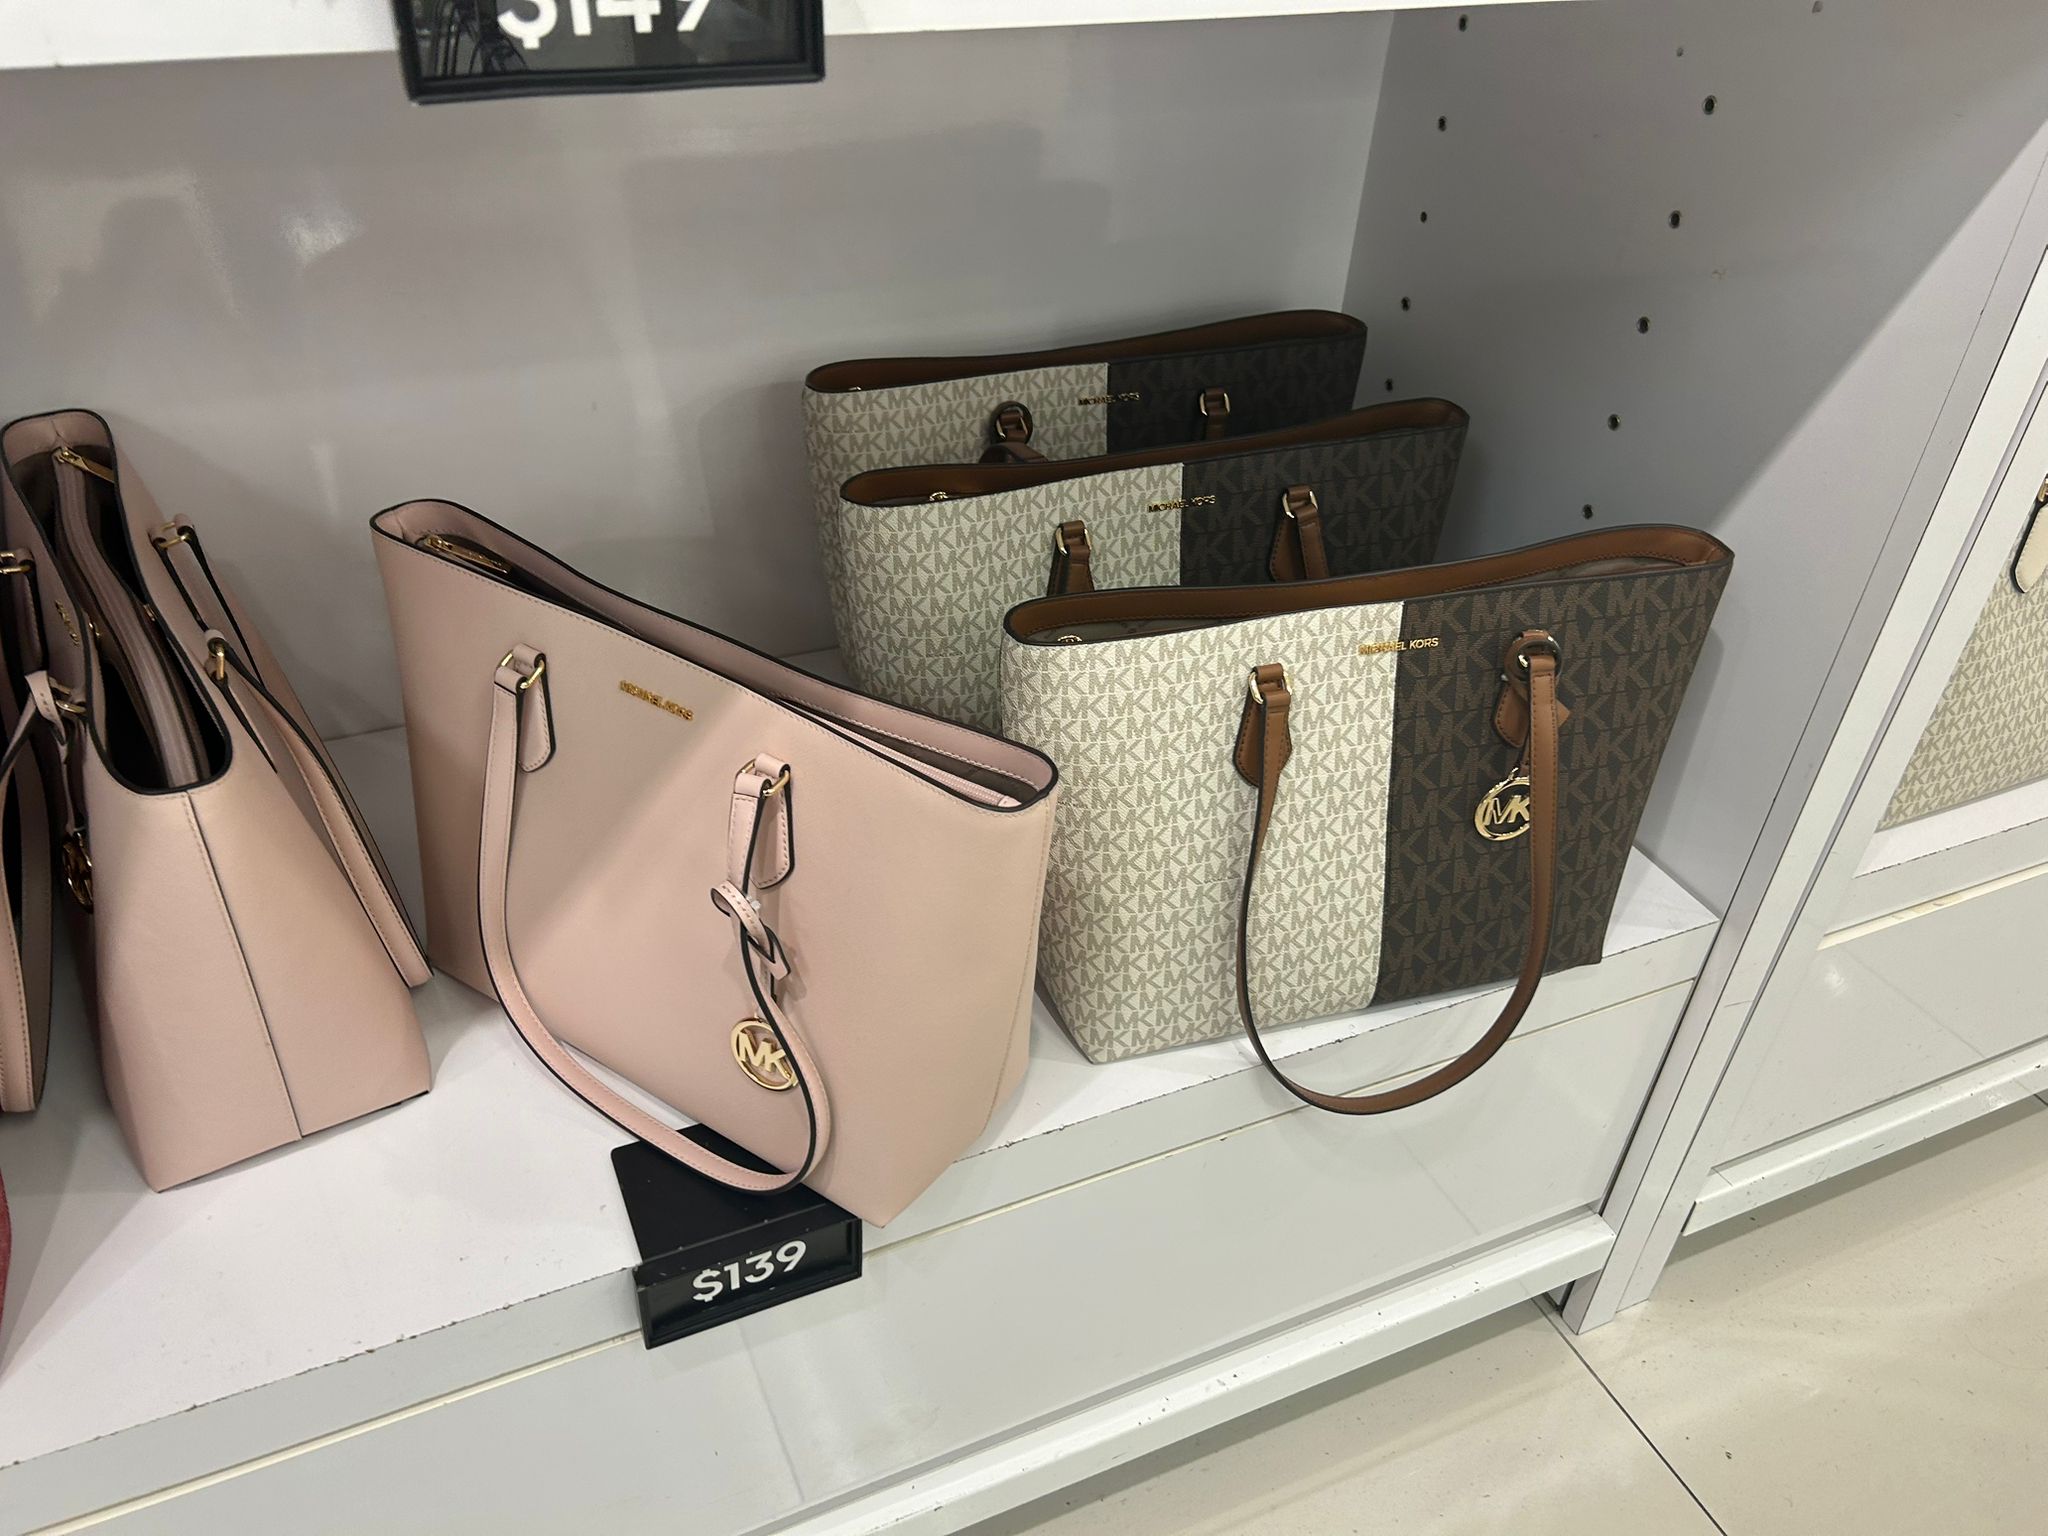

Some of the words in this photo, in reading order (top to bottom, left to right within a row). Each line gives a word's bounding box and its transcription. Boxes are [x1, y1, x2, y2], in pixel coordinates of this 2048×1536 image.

[898, 507, 937, 533] MK
[939, 502, 975, 528] MK
[977, 497, 1010, 521] MK
[1013, 490, 1044, 514] MK
[1046, 484, 1077, 508] MK
[1079, 477, 1110, 501] MK
[1112, 472, 1145, 496] MK
[1146, 467, 1179, 491] MK
[1092, 494, 1125, 520] MK
[875, 530, 914, 556] MK
[917, 526, 956, 554] MK
[956, 520, 992, 548] MK
[992, 513, 1025, 541] MK
[1027, 507, 1058, 533] MK
[1106, 513, 1139, 539] MK
[894, 551, 933, 577] MK
[934, 546, 973, 574] MK
[973, 540, 1006, 566] MK
[1007, 532, 1040, 560] MK
[1089, 538, 1120, 564] MK
[1121, 532, 1154, 558] MK
[912, 572, 951, 598] MK
[952, 566, 988, 592] MK
[988, 559, 1021, 585] MK
[1022, 552, 1053, 576] MK
[1103, 557, 1134, 581] MK
[1135, 550, 1168, 576] MK
[890, 595, 929, 619] MK
[930, 591, 969, 617] MK
[970, 585, 1003, 611] MK
[1004, 577, 1035, 601] MK
[908, 615, 947, 639] MK
[949, 610, 985, 636] MK
[1241, 622, 1277, 649] MK
[1281, 616, 1317, 643] MK
[1319, 612, 1358, 637] MK
[1361, 606, 1397, 631] MK
[926, 634, 965, 660] MK
[966, 628, 999, 654] MK
[1296, 636, 1332, 665] MK
[1409, 636, 1440, 650] KORS
[944, 654, 980, 678] MK
[1089, 667, 1131, 696] MK
[1135, 661, 1174, 690] MK
[1176, 655, 1215, 684] MK
[1311, 657, 1347, 684] MK
[1350, 654, 1386, 679] MK
[1108, 689, 1150, 718] MK
[1152, 683, 1191, 712] MK
[1194, 676, 1230, 705] MK
[1326, 678, 1362, 705] MK
[1126, 711, 1168, 740] MK
[1169, 704, 1208, 733] MK
[1303, 704, 1339, 733] MK
[1342, 698, 1378, 725] MK
[1100, 739, 1142, 766] MK
[1145, 732, 1184, 761] MK
[1186, 726, 1222, 753] MK
[1319, 725, 1355, 752] MK
[1118, 760, 1160, 787] MK
[1163, 753, 1199, 780] MK
[1295, 751, 1334, 780] MK
[1335, 745, 1371, 772] MK
[1137, 780, 1176, 807] MK
[1179, 773, 1215, 800] MK
[1312, 772, 1348, 799] MK
[1110, 806, 1152, 833] MK
[1154, 800, 1193, 827] MK
[1195, 792, 1231, 819] MK
[1289, 798, 1325, 825] MK
[1326, 791, 1362, 816] MK
[1128, 826, 1170, 853] MK
[1171, 819, 1210, 846] MK
[1304, 816, 1340, 843] MK
[1147, 845, 1186, 872] MK
[1187, 838, 1226, 865] MK
[1282, 843, 1318, 870] MK
[1319, 835, 1355, 862] MK
[1120, 871, 1162, 896] MK
[1163, 865, 1202, 890] MK
[1260, 869, 1296, 896] MK
[1298, 861, 1334, 888] MK
[1335, 853, 1371, 880] MK
[1139, 889, 1178, 914] MK
[1180, 883, 1219, 908] MK
[1276, 887, 1312, 914] MK
[1313, 880, 1349, 905] MK
[1156, 907, 1195, 932] MK
[1253, 913, 1289, 938] MK
[1291, 905, 1327, 930] MK
[1328, 898, 1364, 923] MK
[1131, 932, 1170, 955] MK
[1172, 925, 1211, 950] MK
[1268, 930, 1304, 955] MK
[1306, 922, 1342, 947] MK
[1148, 949, 1187, 972] MK
[1188, 942, 1227, 967] MK
[1283, 948, 1319, 971] MK
[1321, 940, 1357, 965] MK
[1164, 966, 1203, 989] MK
[1259, 971, 1295, 994] MK
[1298, 964, 1334, 987] MK
[1140, 988, 1179, 1011] MK
[692, 1240, 807, 1303] $139
